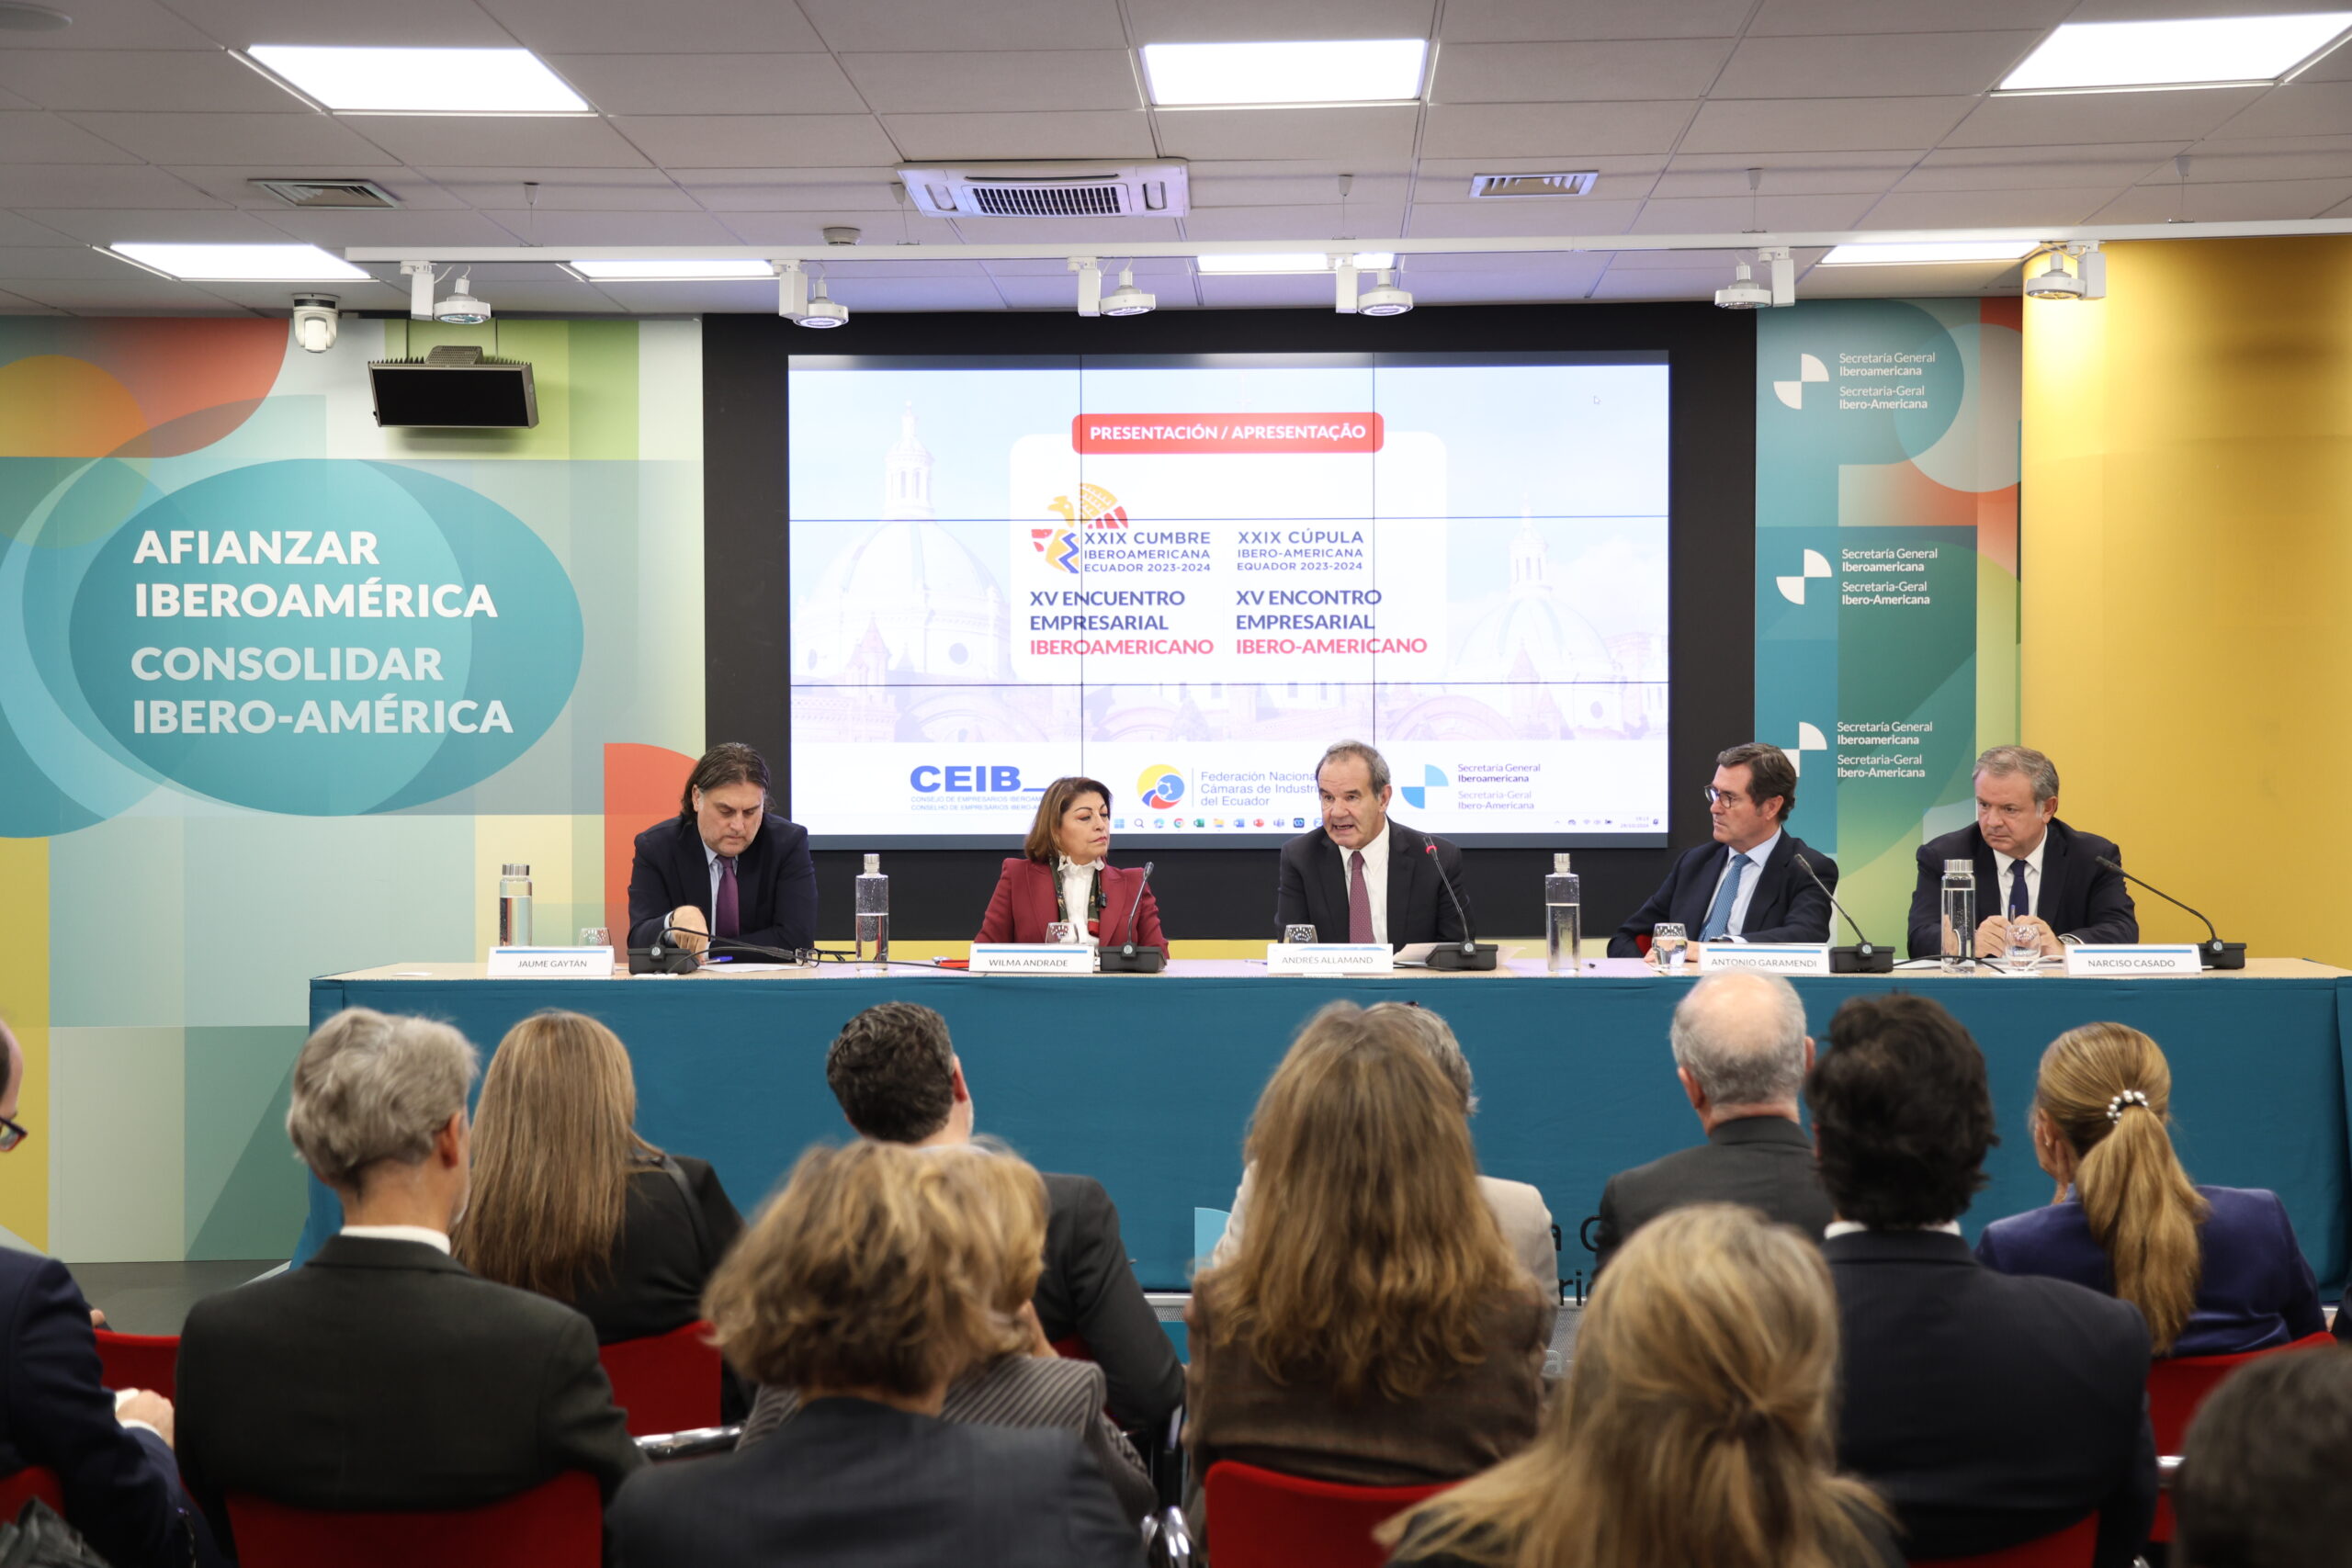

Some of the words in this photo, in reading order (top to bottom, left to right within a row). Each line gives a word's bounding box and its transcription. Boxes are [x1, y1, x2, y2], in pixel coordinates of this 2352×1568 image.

[1894, 352, 1936, 364] General
[1839, 366, 1922, 377] Iberoamericana
[1839, 386, 1925, 397] Secretaria-Geral
[1839, 399, 1928, 410] Ibero-Americana
[1090, 423, 1216, 440] PRESENTACIÓN
[1231, 423, 1366, 442] APRESENTAÇÃO
[1084, 531, 1127, 545] XXIX
[1134, 531, 1211, 545] CUMBRE
[1238, 531, 1282, 545] XXIX
[1288, 527, 1363, 544] CÚPULA
[132, 530, 380, 565] AFIANZAR
[1238, 548, 1363, 558] IBERO-AMERICANA
[1842, 548, 1894, 559] Secretaría
[1896, 547, 1938, 558] General
[1084, 549, 1211, 559] IBEROAMERICANA
[1084, 563, 1144, 572] ECUADOR
[1147, 562, 1211, 572] 2023-2024
[1237, 562, 1297, 571] EQUADOR
[1300, 561, 1363, 571] 2023-2024
[1842, 561, 1925, 572] Iberoamericana
[1842, 581, 1928, 592] Secretaria-Geral
[135, 577, 499, 618] IBEROAMÉRICA
[1030, 591, 1058, 606] XV
[1063, 591, 1186, 606] ENCUENTRO
[1236, 590, 1264, 606] XV
[1269, 589, 1382, 606] ENCONTRO
[1842, 594, 1930, 605] Ibero-Americana
[1030, 615, 1170, 631] EMPRESARIAL
[1236, 614, 1375, 630] EMPRESARIAL
[1030, 638, 1215, 656] IBEROAMERICANO
[1236, 637, 1428, 655] IBERO-AMERICANO
[131, 647, 444, 682] CONSOLIDAR
[133, 693, 514, 734] IBERO-AMÉRICA
[1837, 721, 1890, 732] Secretaría
[1891, 721, 1933, 732] General
[1837, 735, 1920, 745] Iberoamericana
[1837, 754, 1922, 765] Secretaria-Geral
[1505, 763, 1541, 773] General
[1837, 767, 1926, 778] Ibero-Americana
[1201, 771, 1266, 782] Federación
[1457, 774, 1530, 783] Iberoamericana
[1201, 783, 1254, 794] Cámaras
[1256, 784, 1272, 794] de
[1457, 790, 1532, 799] Secretaria-Geral
[1200, 795, 1218, 807] del
[1222, 795, 1271, 807] Ecuador
[1457, 801, 1535, 809] Ibero-Americana
[517, 960, 549, 968] JAUME
[550, 959, 588, 968] GAYTÁN
[989, 959, 1021, 967] WILMA
[1022, 959, 1069, 967] ANDRADE
[1282, 955, 1319, 964] ANDRÉS
[1320, 956, 1374, 964] ALLAMAND
[1711, 958, 1757, 966] ANTONIO
[1758, 959, 1817, 967] GARAMENDI
[2087, 959, 2132, 967] NARCISO
[2133, 959, 2176, 967] CASADO
